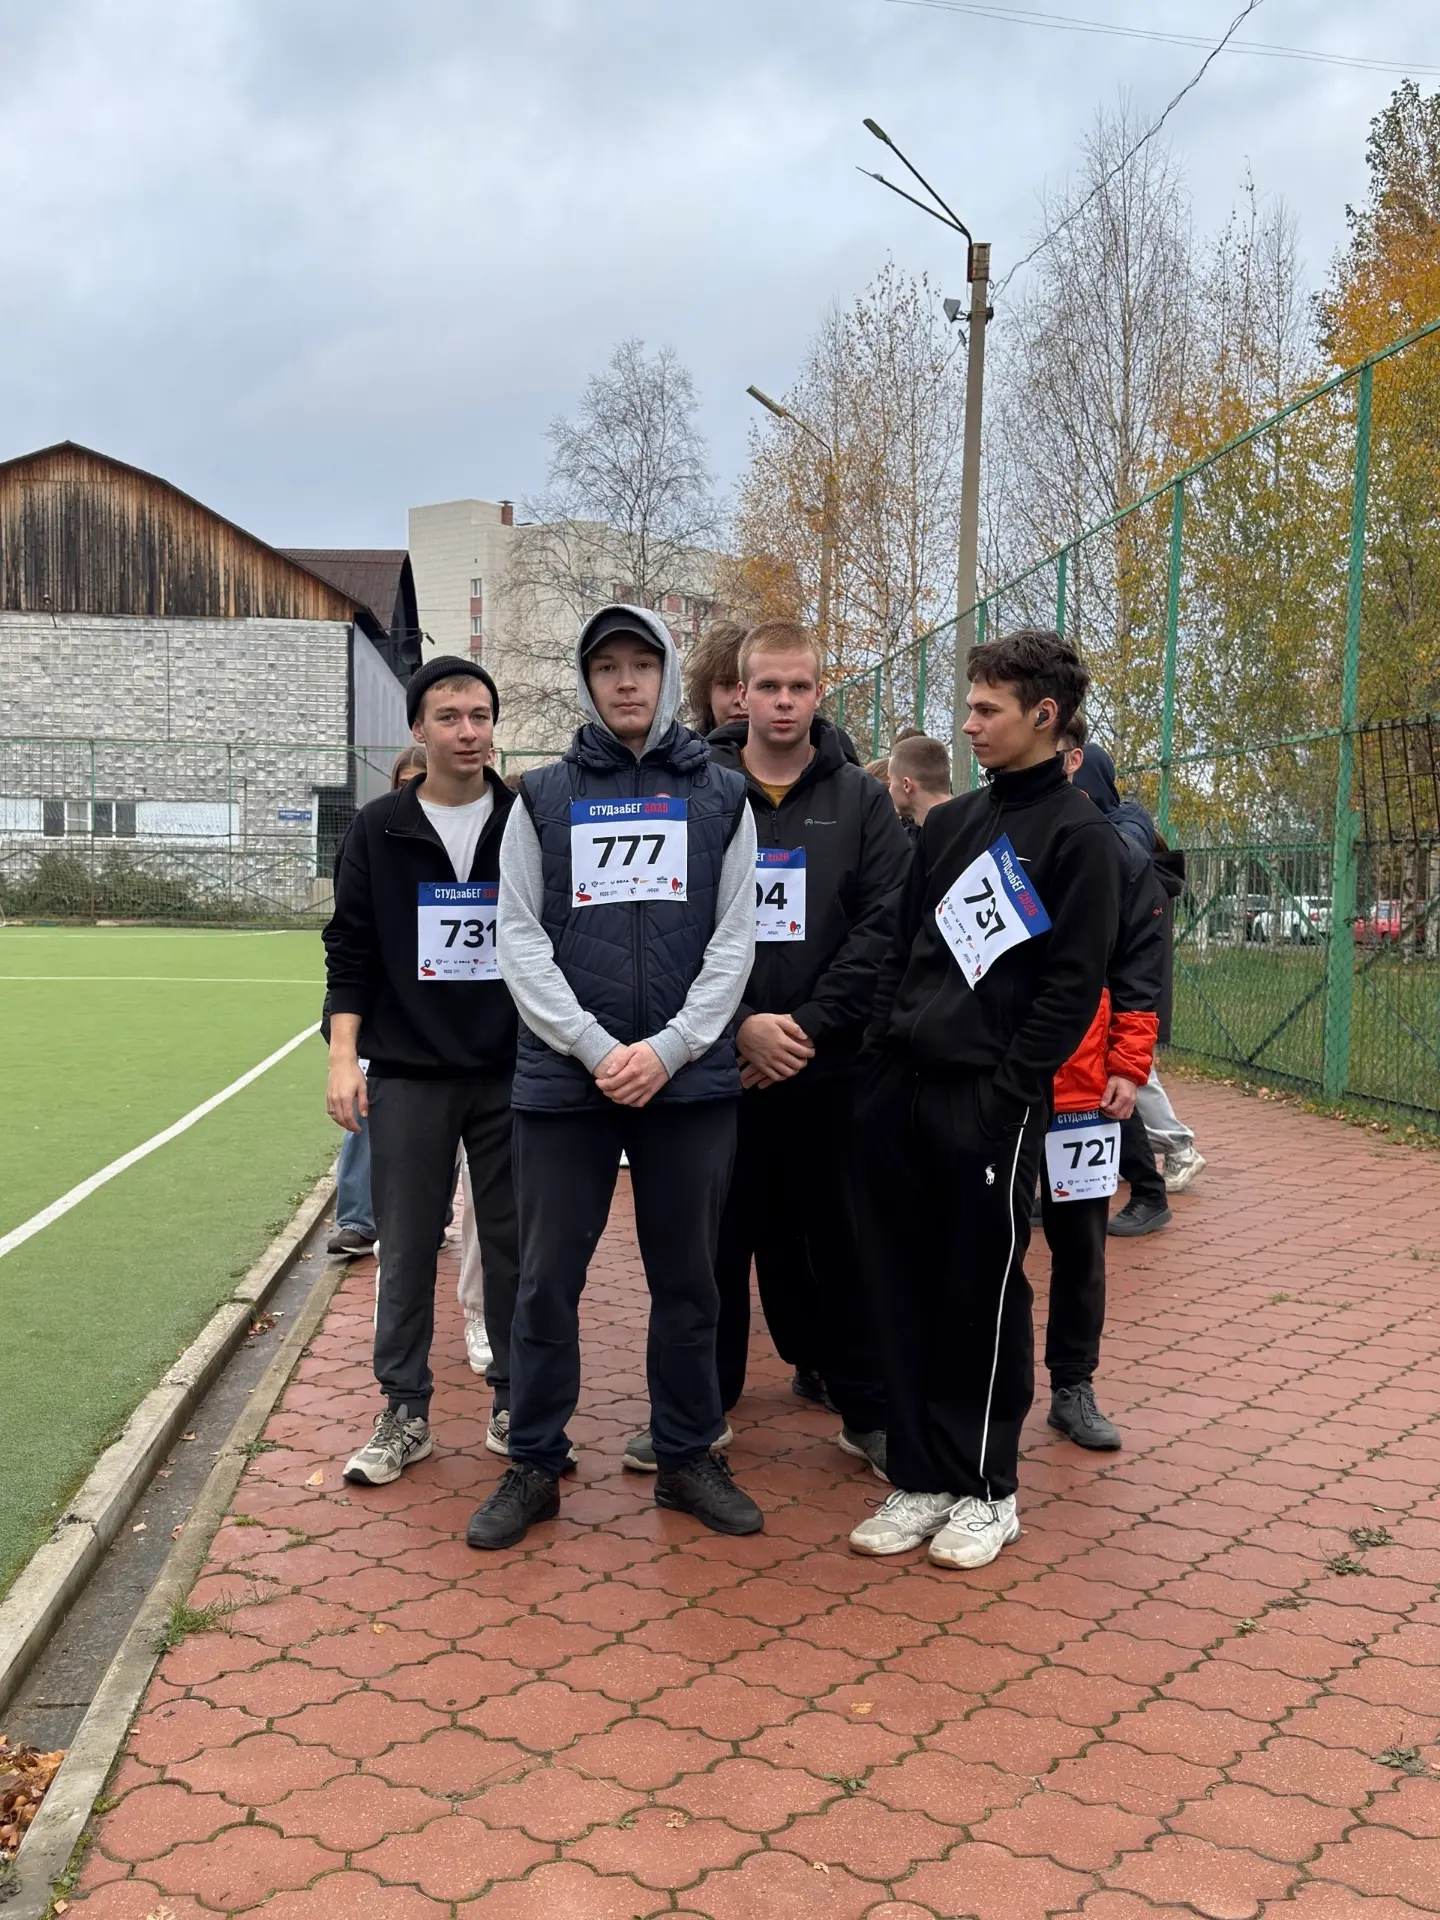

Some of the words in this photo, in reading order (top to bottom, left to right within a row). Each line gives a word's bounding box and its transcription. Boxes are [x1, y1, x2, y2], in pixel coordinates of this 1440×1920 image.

[589, 803, 642, 816] СТУДзаБЕГ
[592, 834, 666, 868] 777
[1000, 851, 1026, 892] СТУДзаБЕГ
[434, 888, 482, 900] СТУДзаБЕГ
[963, 877, 1007, 941] 737
[440, 919, 497, 948] 731
[1062, 1136, 1116, 1170] 727
